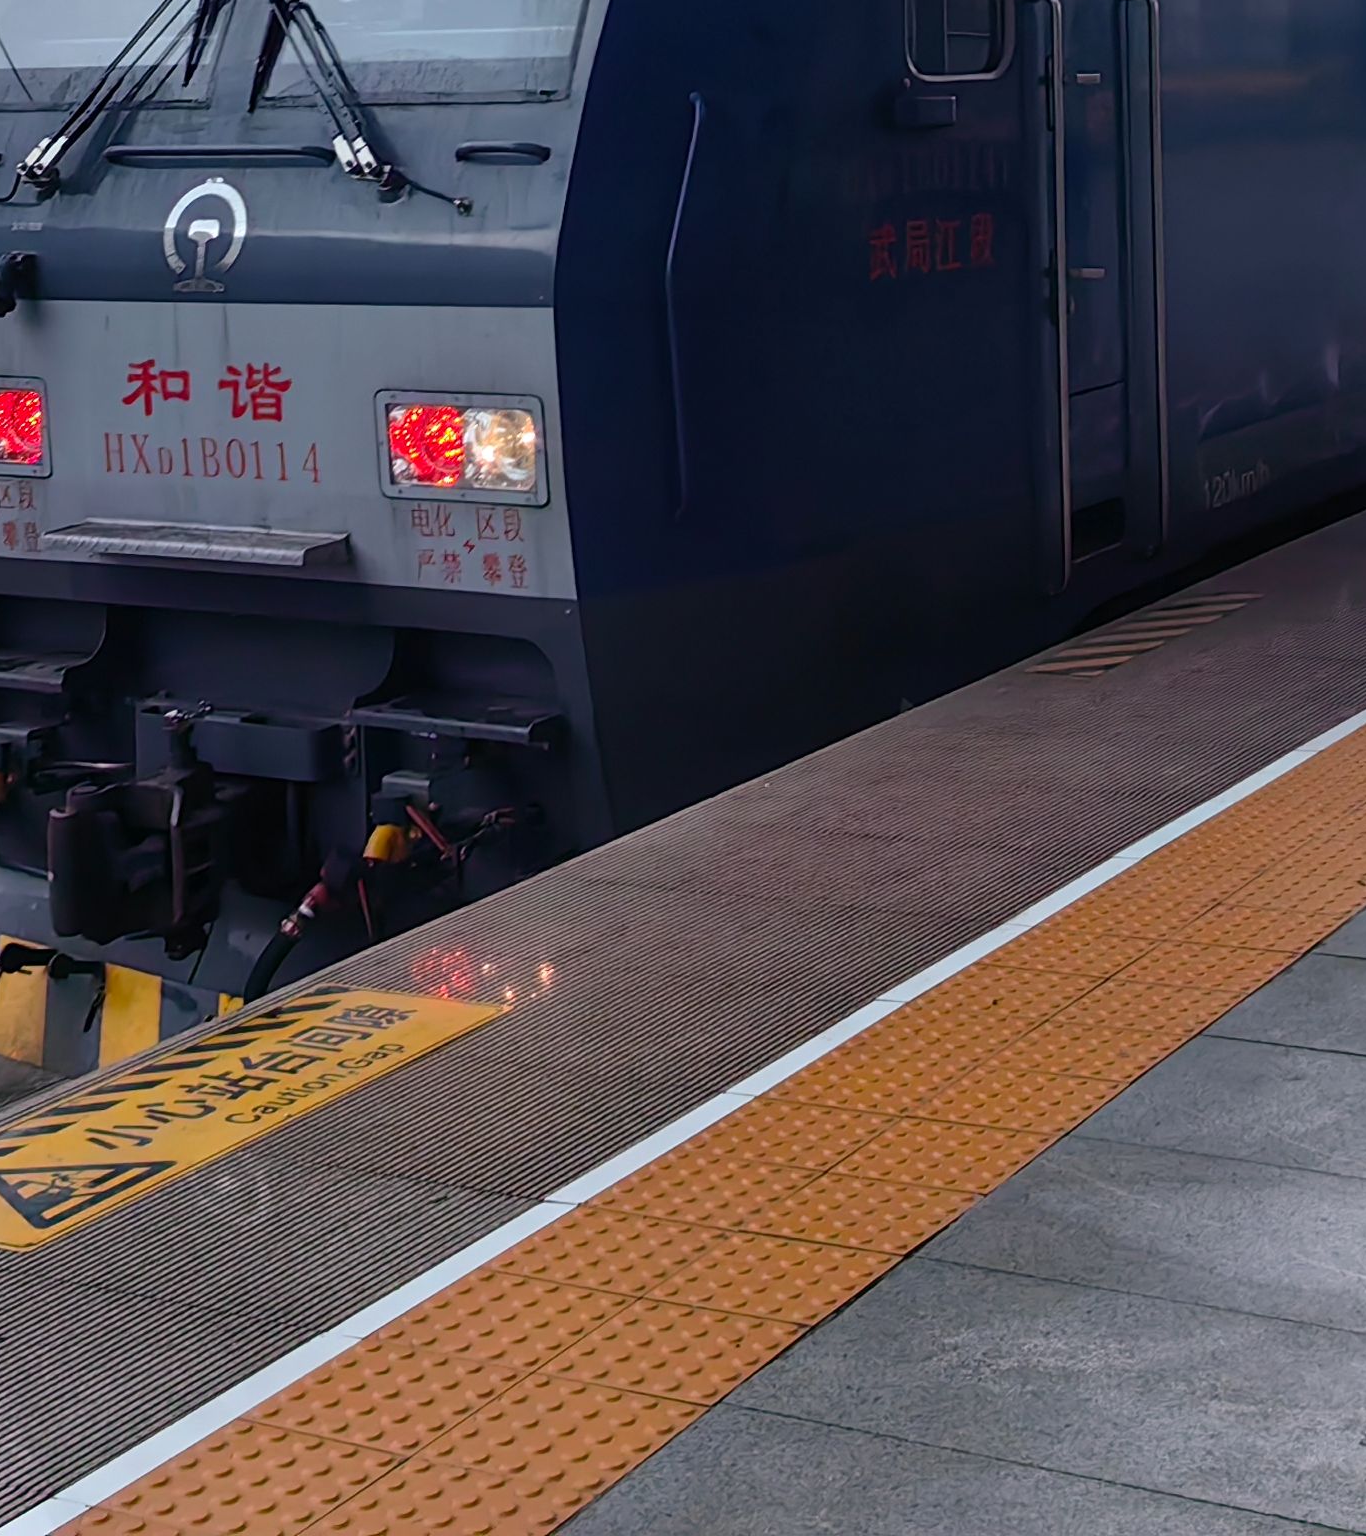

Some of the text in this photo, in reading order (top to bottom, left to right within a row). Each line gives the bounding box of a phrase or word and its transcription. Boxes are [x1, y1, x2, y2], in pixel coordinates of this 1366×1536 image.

[121, 358, 293, 423] 和谐
[84, 1003, 418, 1151] 小心站台间隙
